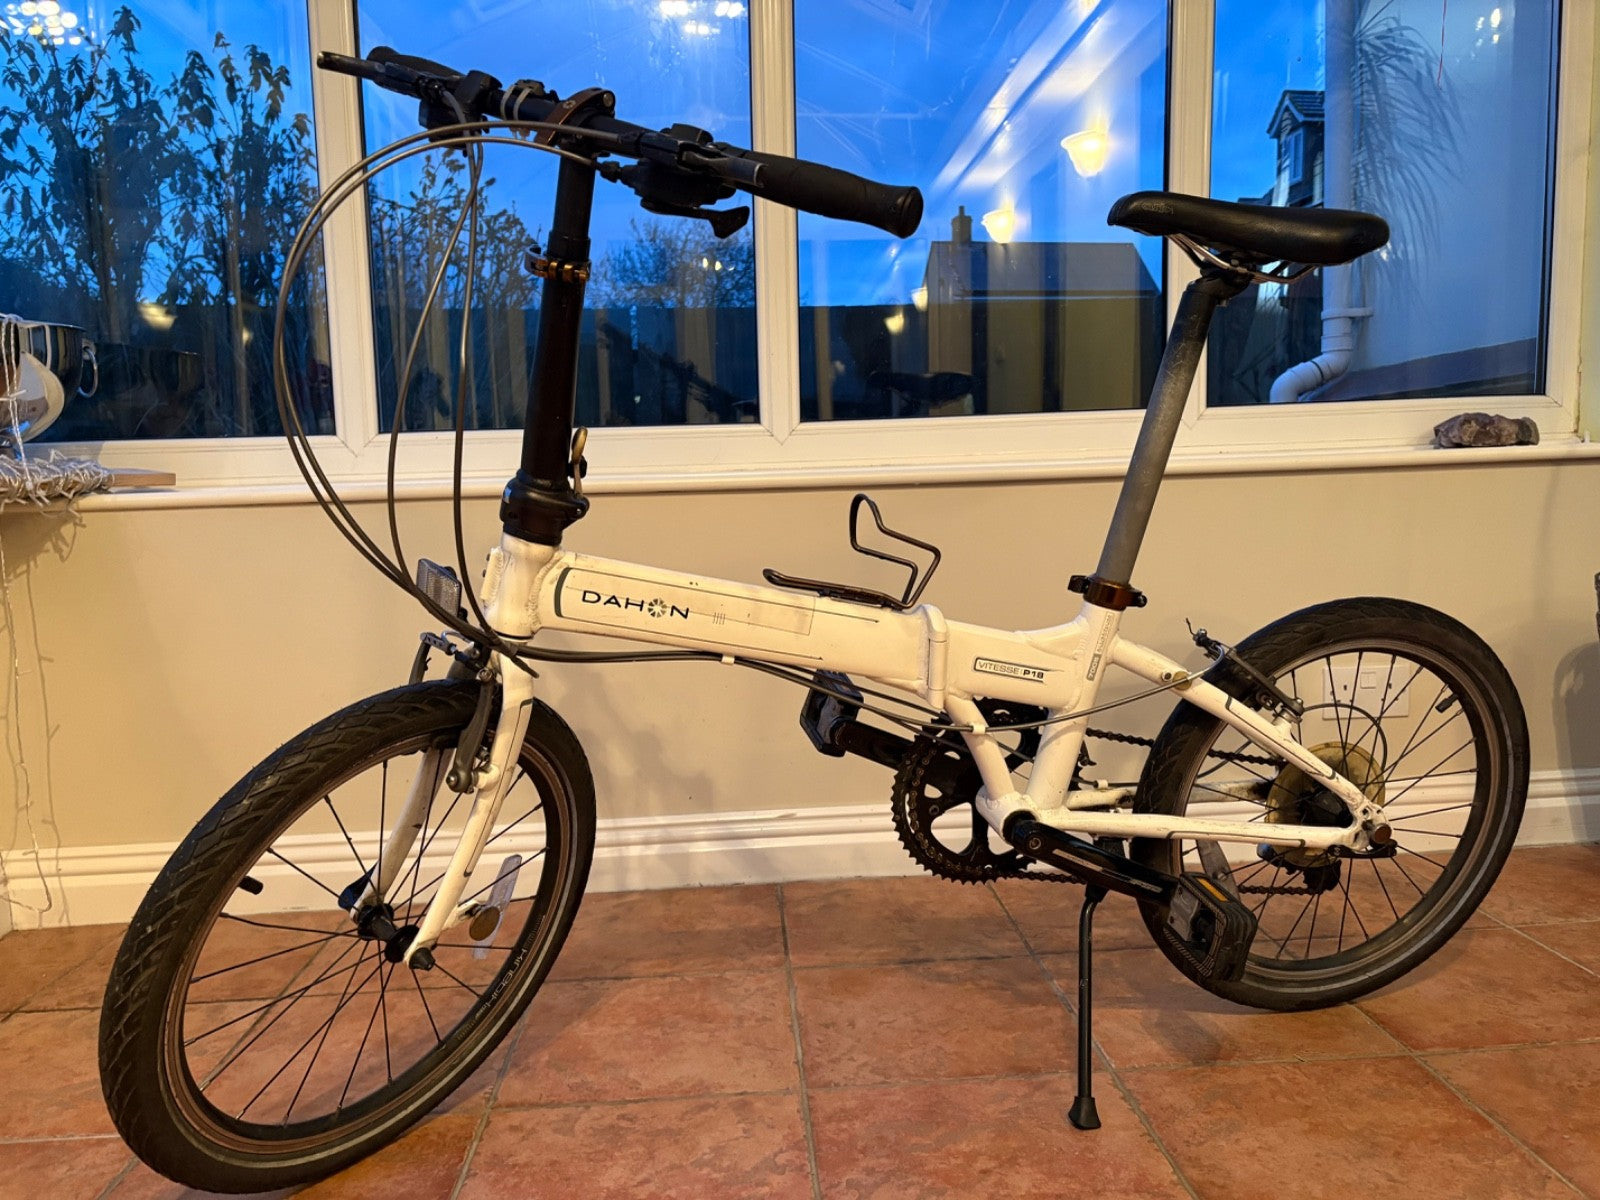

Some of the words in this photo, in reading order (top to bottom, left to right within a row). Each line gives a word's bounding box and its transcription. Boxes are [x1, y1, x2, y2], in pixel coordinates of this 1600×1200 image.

[582, 590, 689, 619] DAHON
[979, 661, 1020, 675] VITESSE
[1023, 669, 1044, 679] P18
